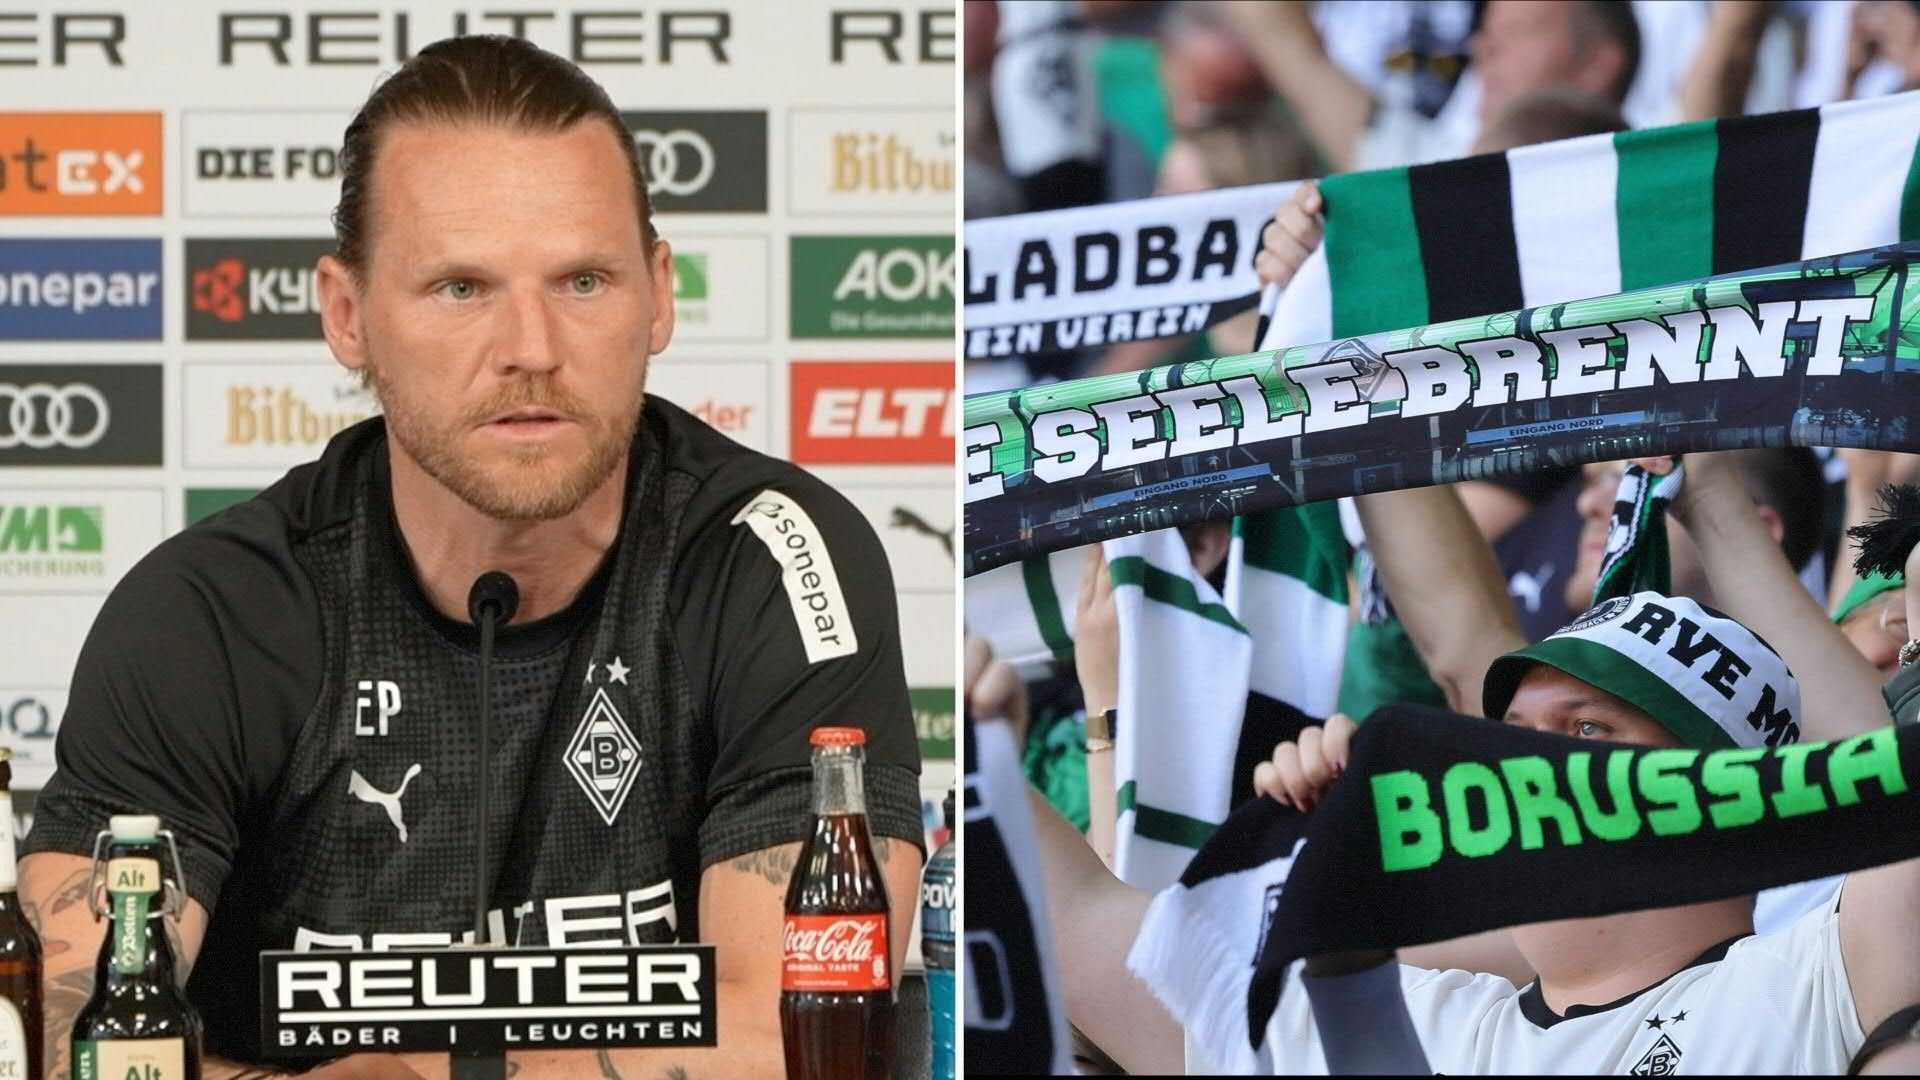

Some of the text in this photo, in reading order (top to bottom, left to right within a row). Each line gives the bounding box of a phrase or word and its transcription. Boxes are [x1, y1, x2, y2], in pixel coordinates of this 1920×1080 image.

[198, 149, 274, 179] DIE
[834, 250, 955, 301] AOK
[964, 218, 1276, 304] LADBA
[1055, 303, 1212, 350] VEREIN
[1032, 358, 1371, 484] SEELE
[1384, 297, 1876, 419] BRENNT
[1510, 418, 1604, 436] EINGANG NORD
[1133, 473, 1227, 497] EINGANG NORD
[775, 518, 841, 646] sonepar
[355, 680, 401, 736] EP
[1370, 725, 1908, 873] BORUSSIA
[118, 868, 145, 888] Alt
[784, 920, 878, 960] Coca-Cola
[278, 953, 701, 1009] REUTER
[828, 963, 860, 972] TASTE
[279, 1026, 401, 1047] BÄDER
[505, 1021, 703, 1043] LEUCHTEN
